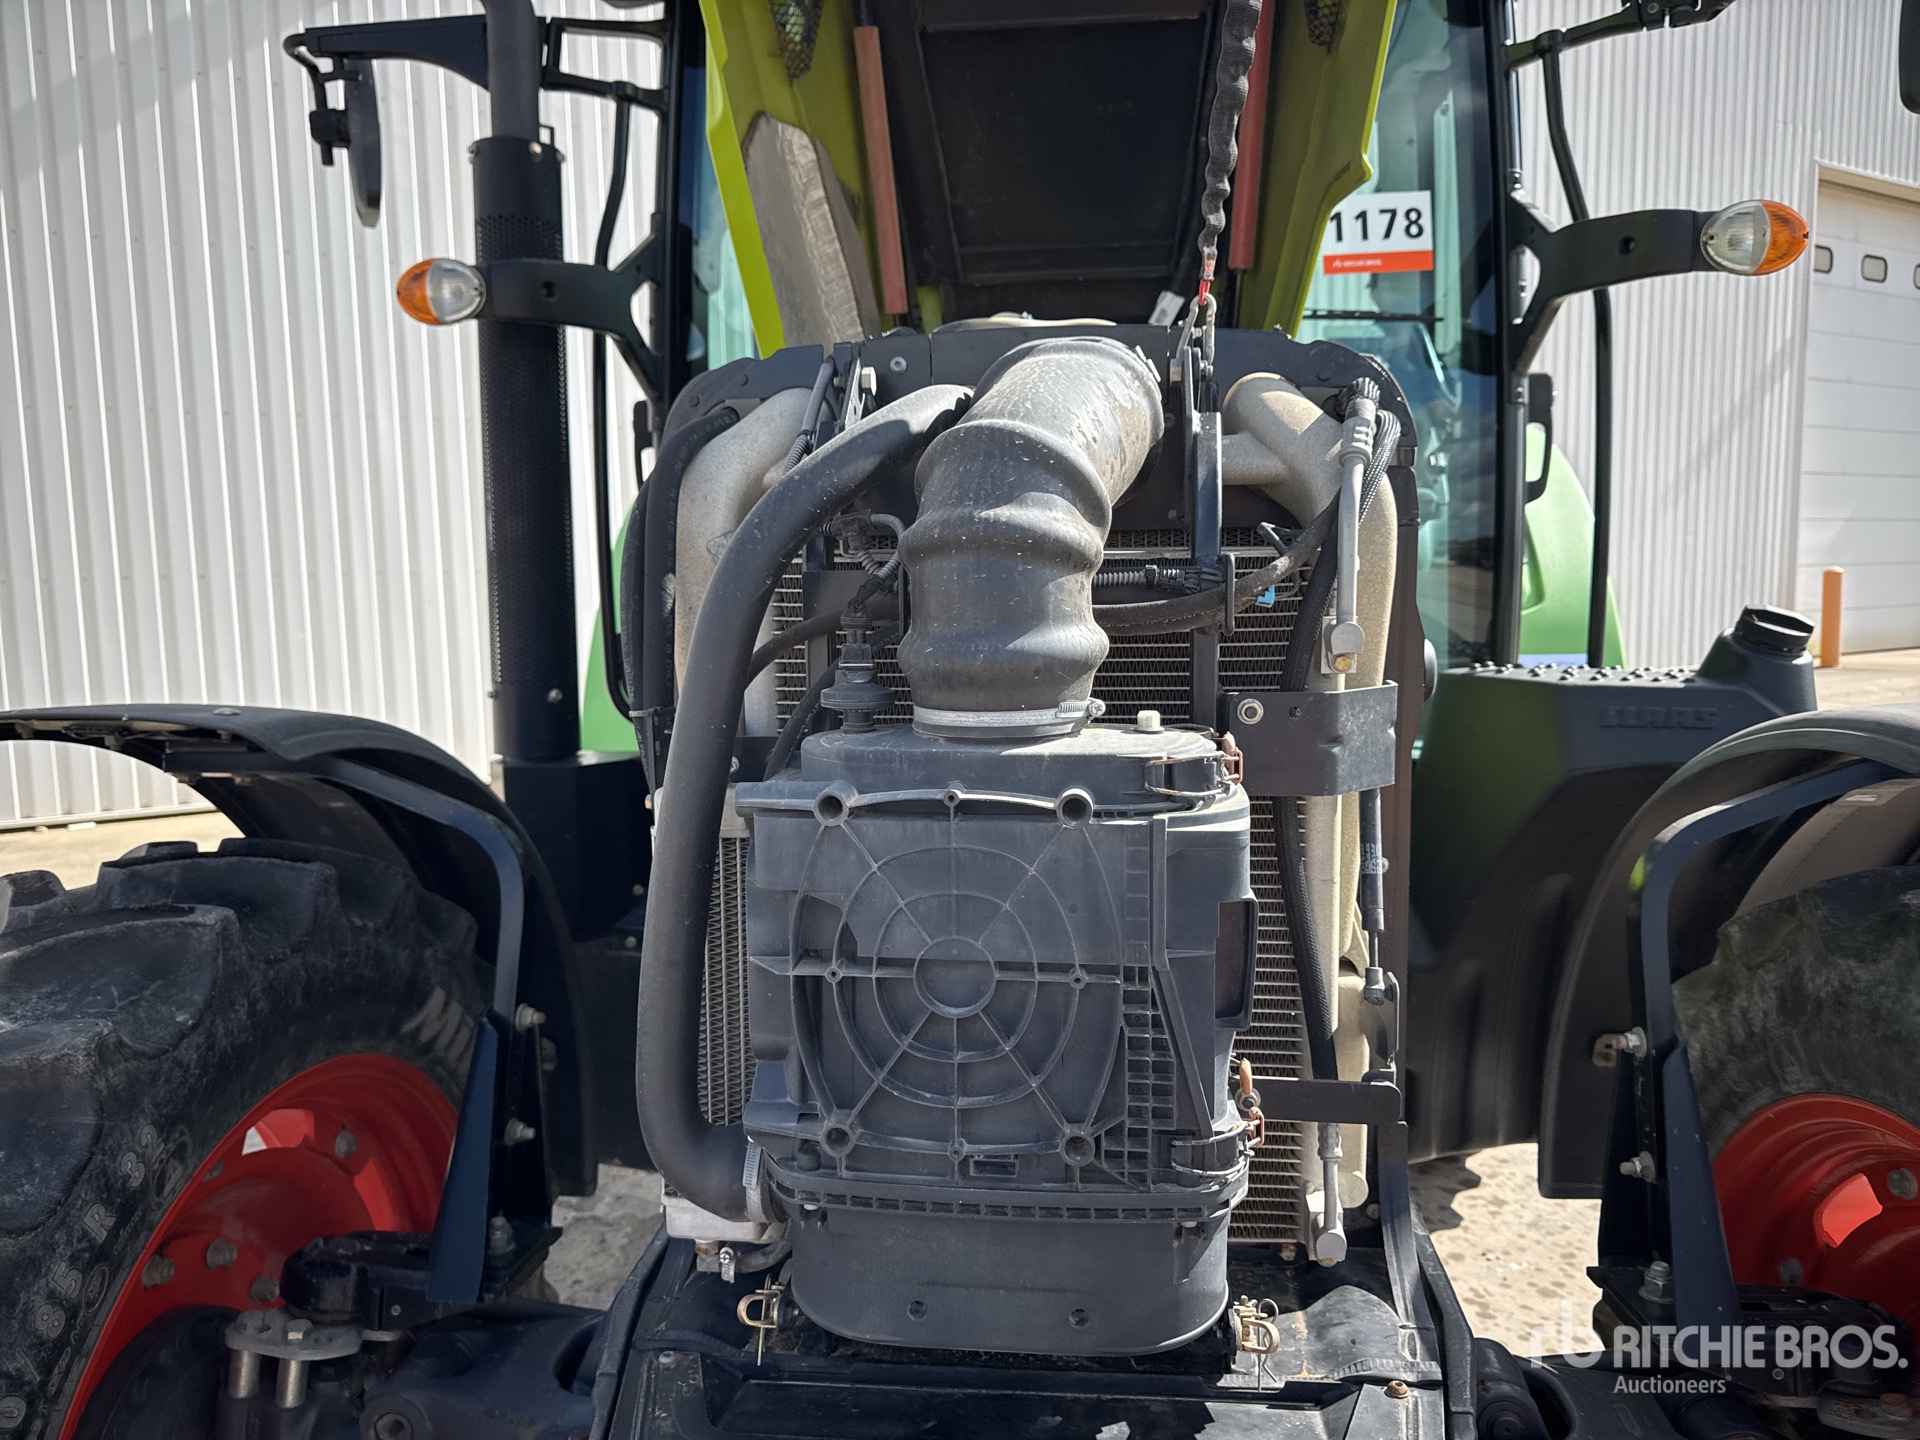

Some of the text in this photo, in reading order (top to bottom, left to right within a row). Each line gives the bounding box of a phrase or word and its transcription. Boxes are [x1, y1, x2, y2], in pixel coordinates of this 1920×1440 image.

[1329, 208, 1424, 242] 1178
[1598, 706, 1718, 730] CLAAS
[118, 1123, 166, 1188] 32
